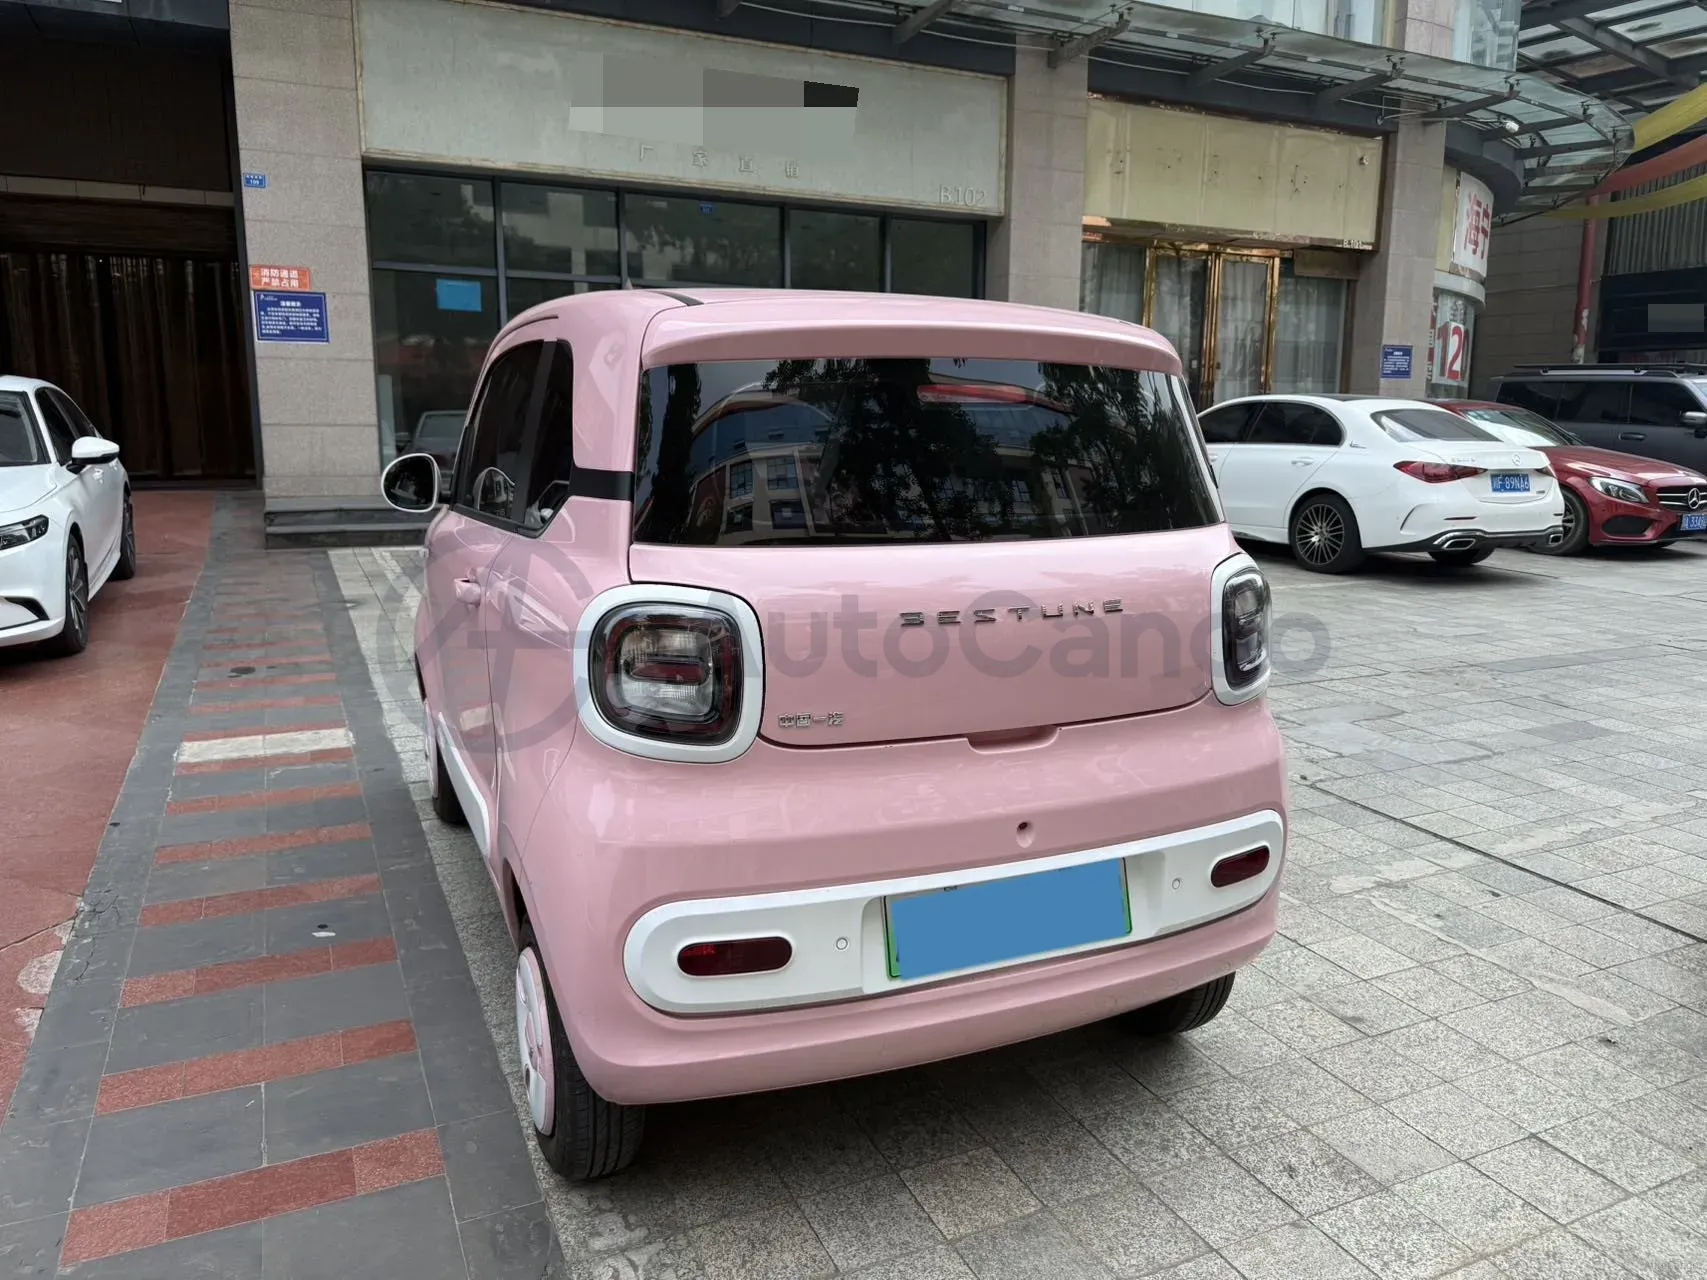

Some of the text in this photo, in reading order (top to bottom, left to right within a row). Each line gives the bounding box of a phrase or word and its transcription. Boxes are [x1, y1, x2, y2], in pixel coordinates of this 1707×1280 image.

[260, 267, 299, 279] 消防通道
[260, 277, 299, 289] 严禁占用
[900, 599, 1124, 626] BESTUNE
[778, 711, 844, 729] 中国一汽
